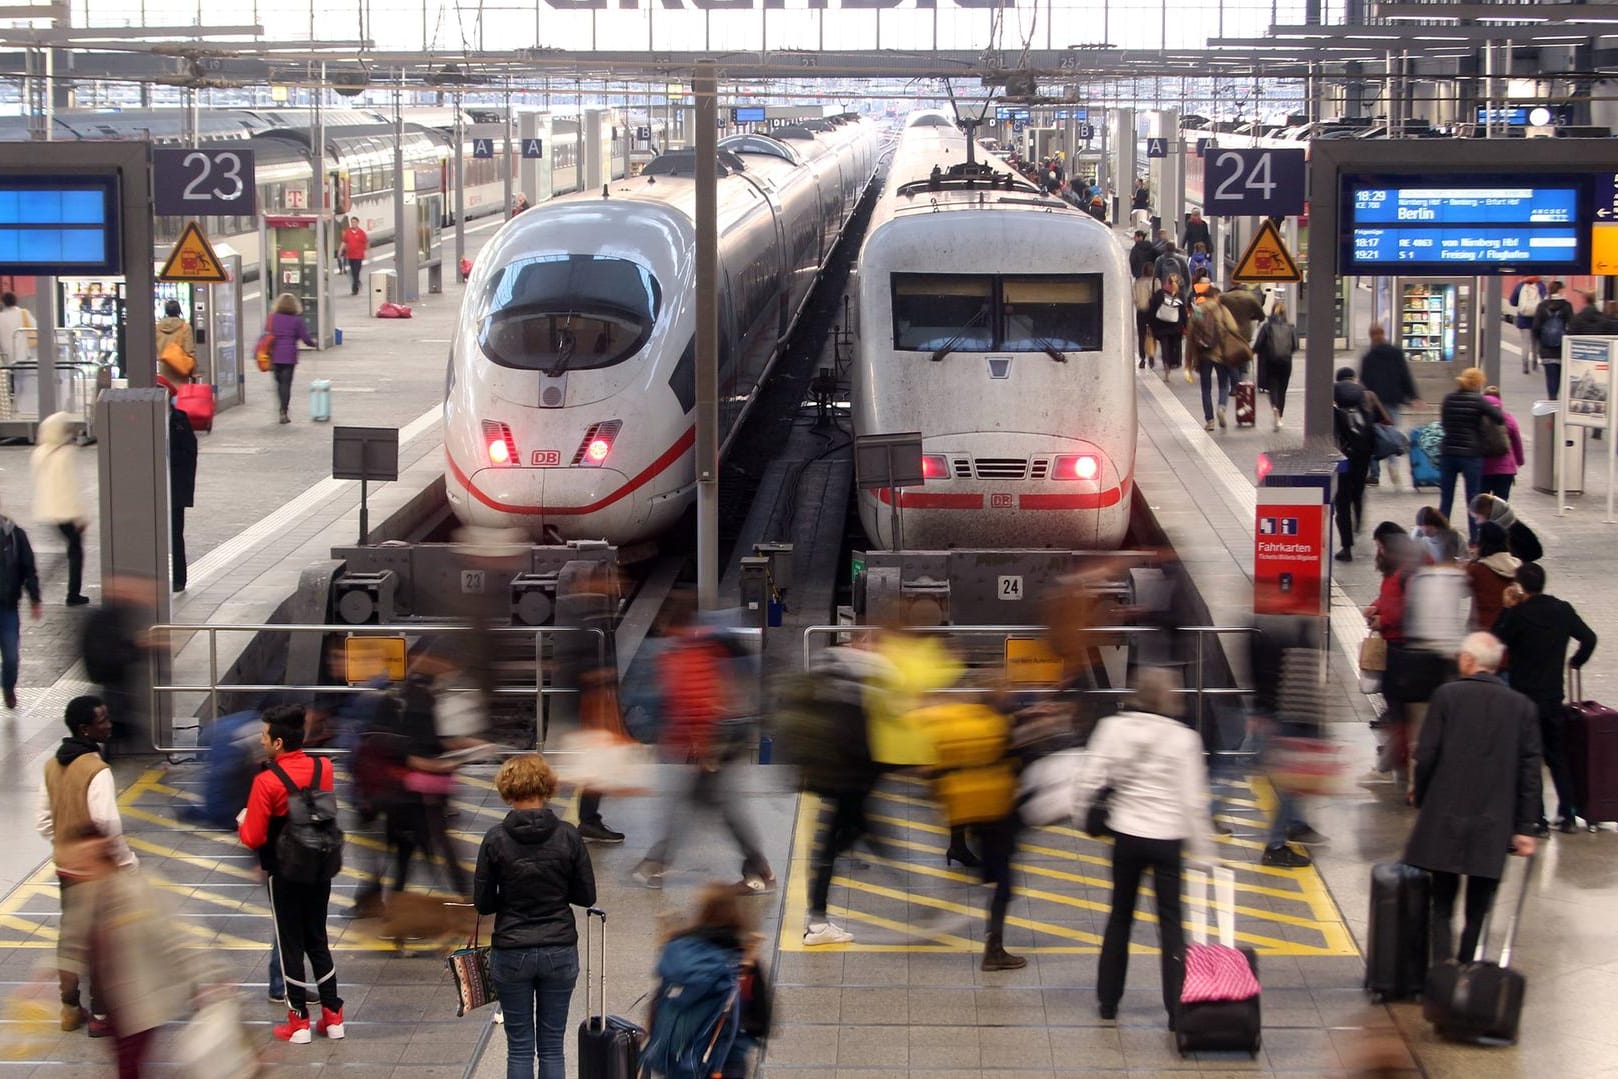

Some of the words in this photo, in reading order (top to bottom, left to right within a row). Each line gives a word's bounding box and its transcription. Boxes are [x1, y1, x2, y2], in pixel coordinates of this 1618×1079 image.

[642, 128, 650, 138] B
[1080, 126, 1089, 137] B
[475, 140, 488, 154] A
[527, 140, 540, 154] A
[1150, 140, 1162, 154] A
[182, 152, 244, 200] 23
[1213, 151, 1278, 200] 24
[1356, 190, 1386, 201] 18:29
[1397, 207, 1434, 220] Berlin
[1355, 238, 1380, 247] 18:17
[1355, 250, 1379, 259] 19:21
[1398, 251, 1406, 259] S
[1408, 251, 1414, 259] 1
[534, 452, 558, 464] DB
[993, 495, 1011, 506] DB
[1258, 542, 1311, 552] Fahrkarten
[1003, 579, 1018, 594] 24
